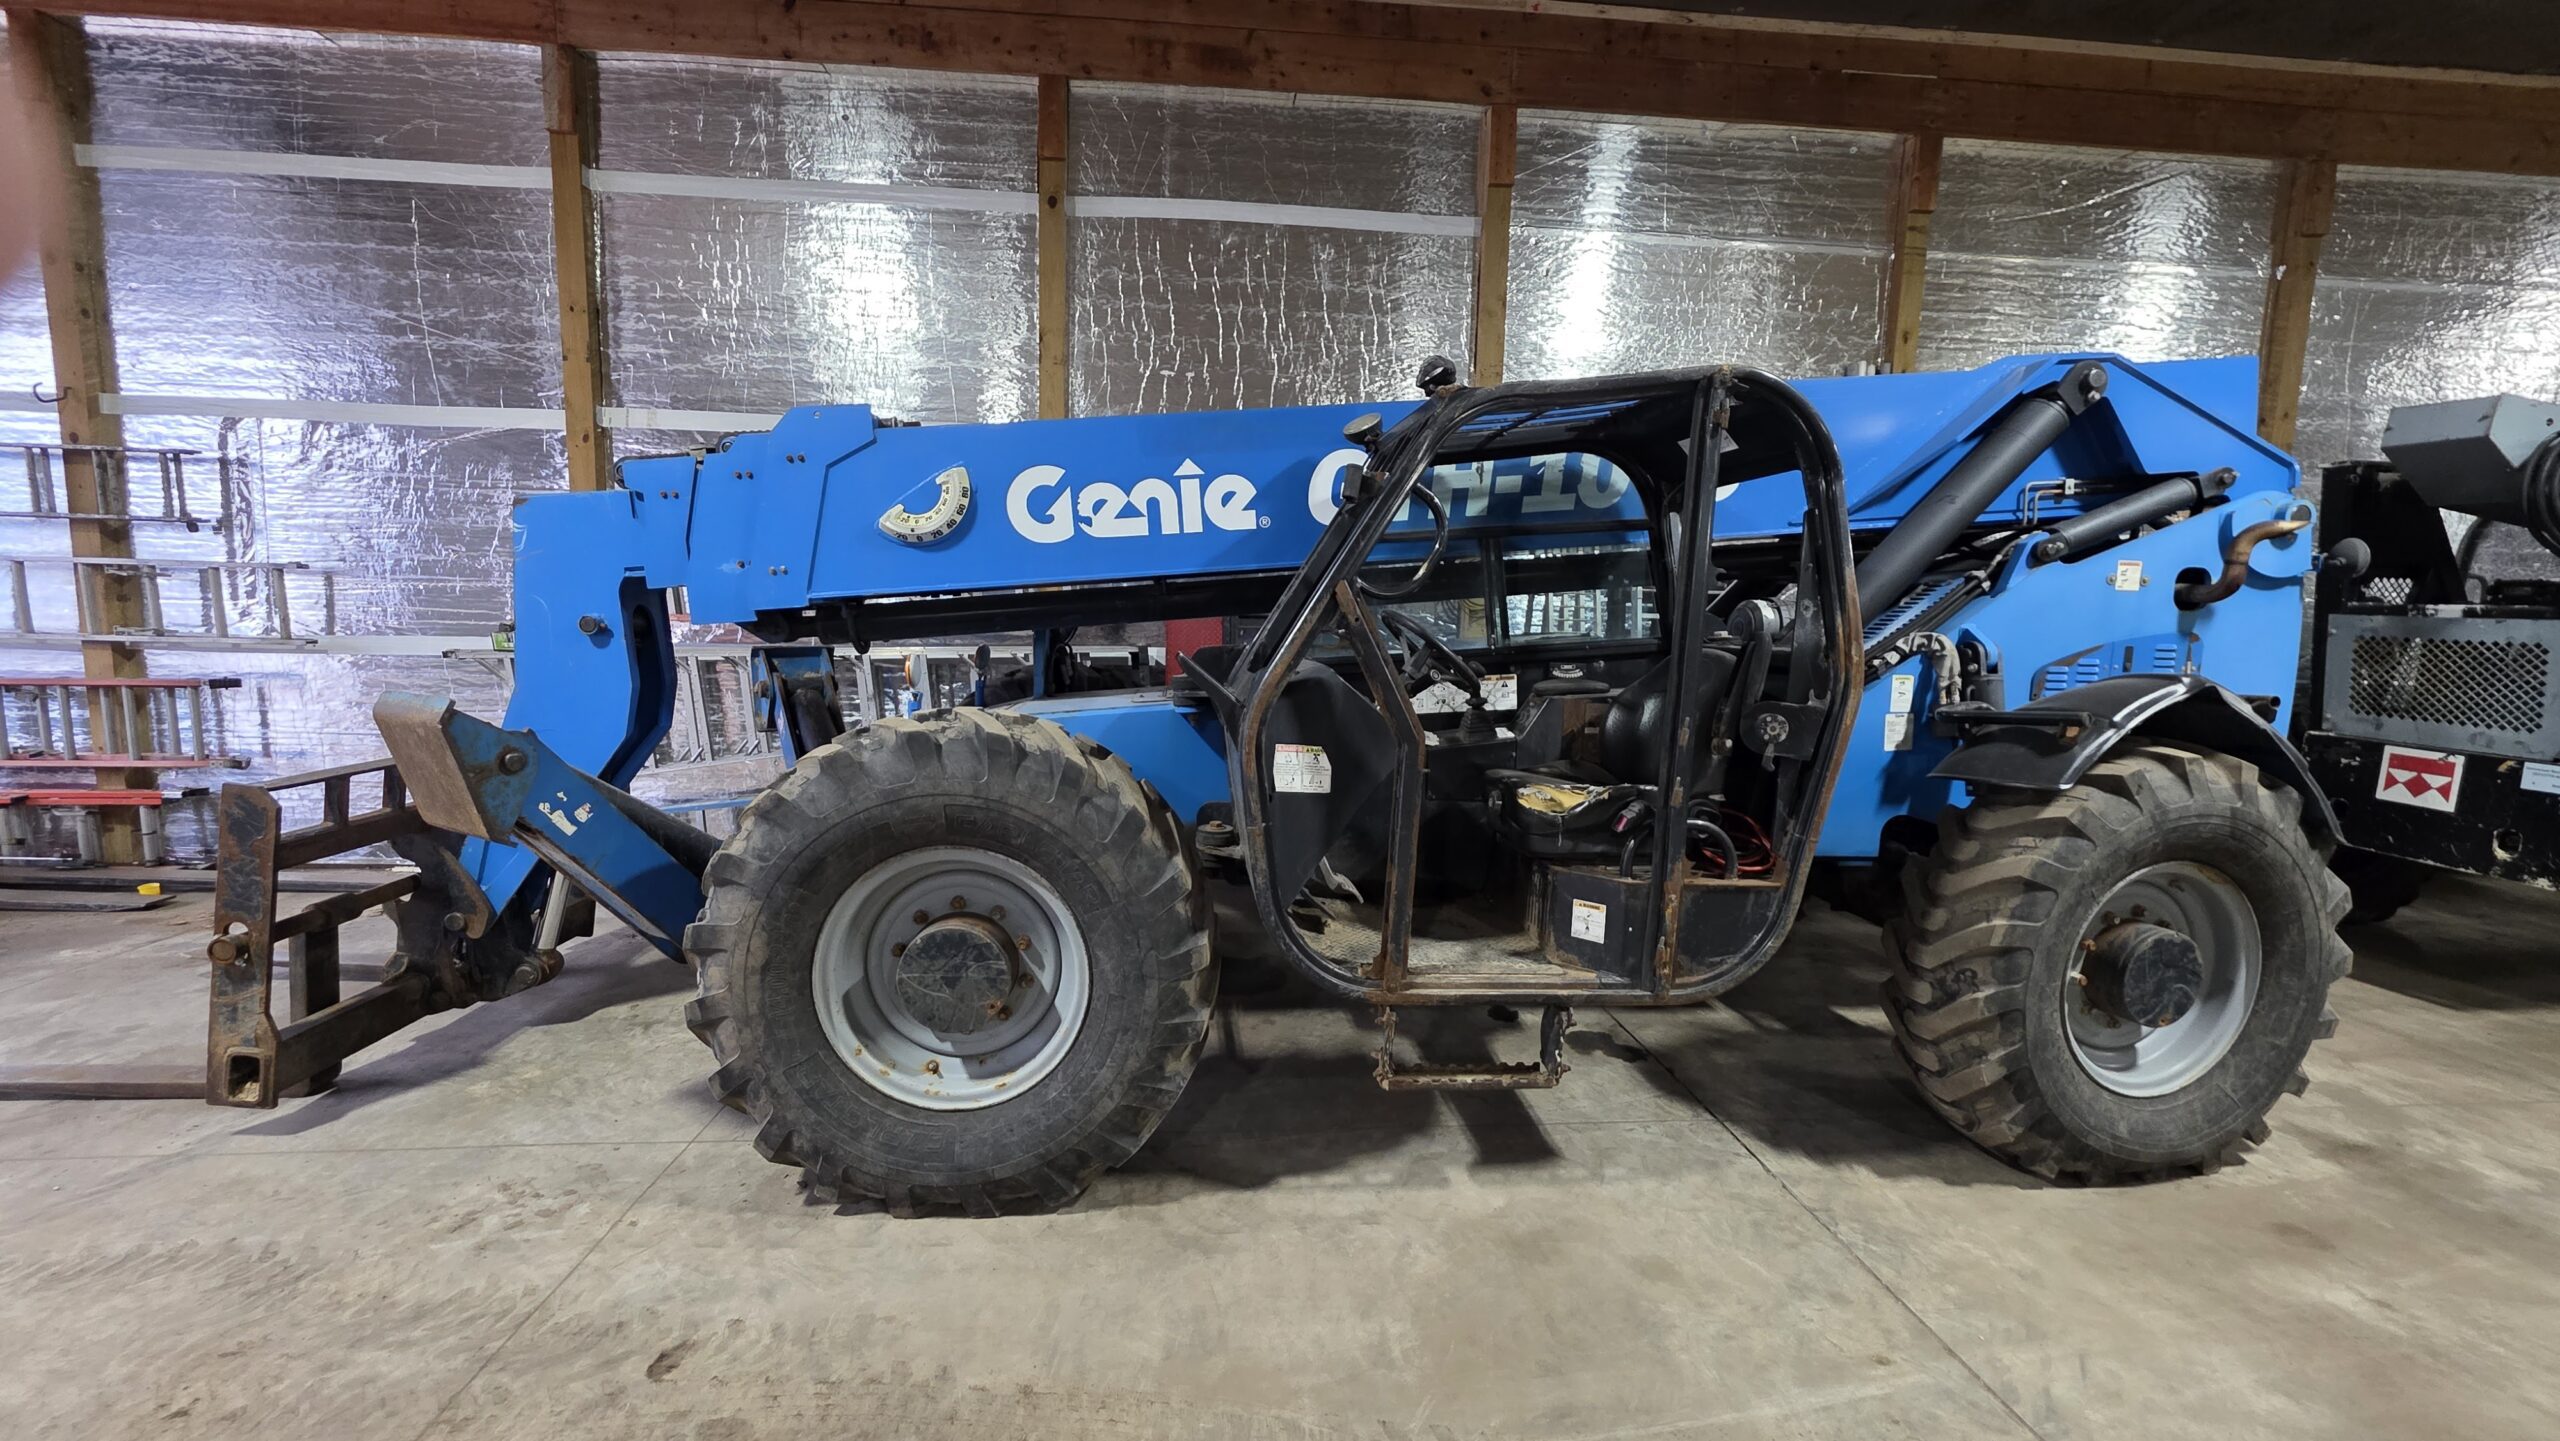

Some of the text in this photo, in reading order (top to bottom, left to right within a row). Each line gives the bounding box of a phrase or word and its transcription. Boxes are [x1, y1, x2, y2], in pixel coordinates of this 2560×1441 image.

[947, 519, 957, 529] 40
[957, 504, 966, 515] 60
[962, 486, 969, 498] 80
